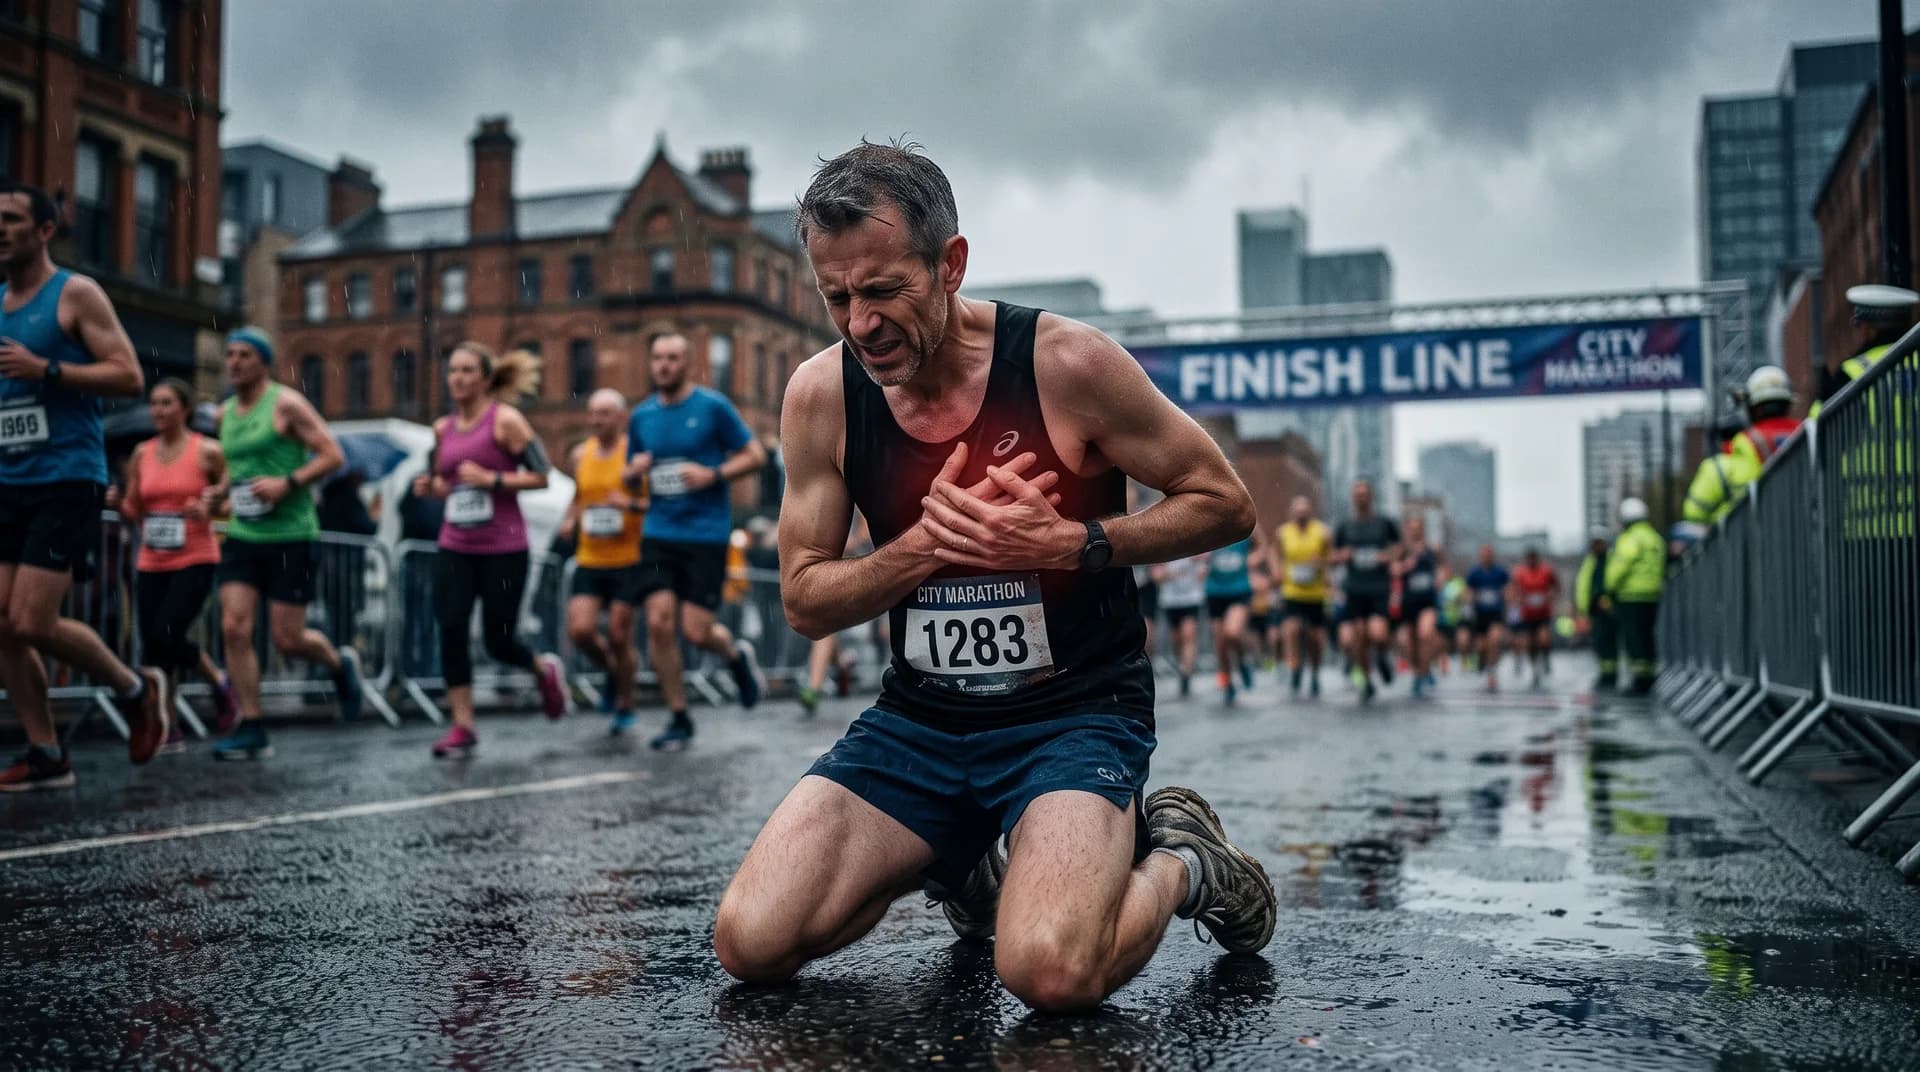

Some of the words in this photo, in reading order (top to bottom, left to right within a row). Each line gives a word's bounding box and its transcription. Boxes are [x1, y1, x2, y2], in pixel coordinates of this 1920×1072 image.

[1577, 327, 1647, 358] CITY
[1180, 347, 1365, 400] FINISH
[1380, 340, 1513, 393] LINE
[1544, 353, 1684, 387] MARATHON
[917, 586, 943, 604] CITY
[945, 580, 1026, 604] MARATHON
[922, 614, 1029, 668] 1283
